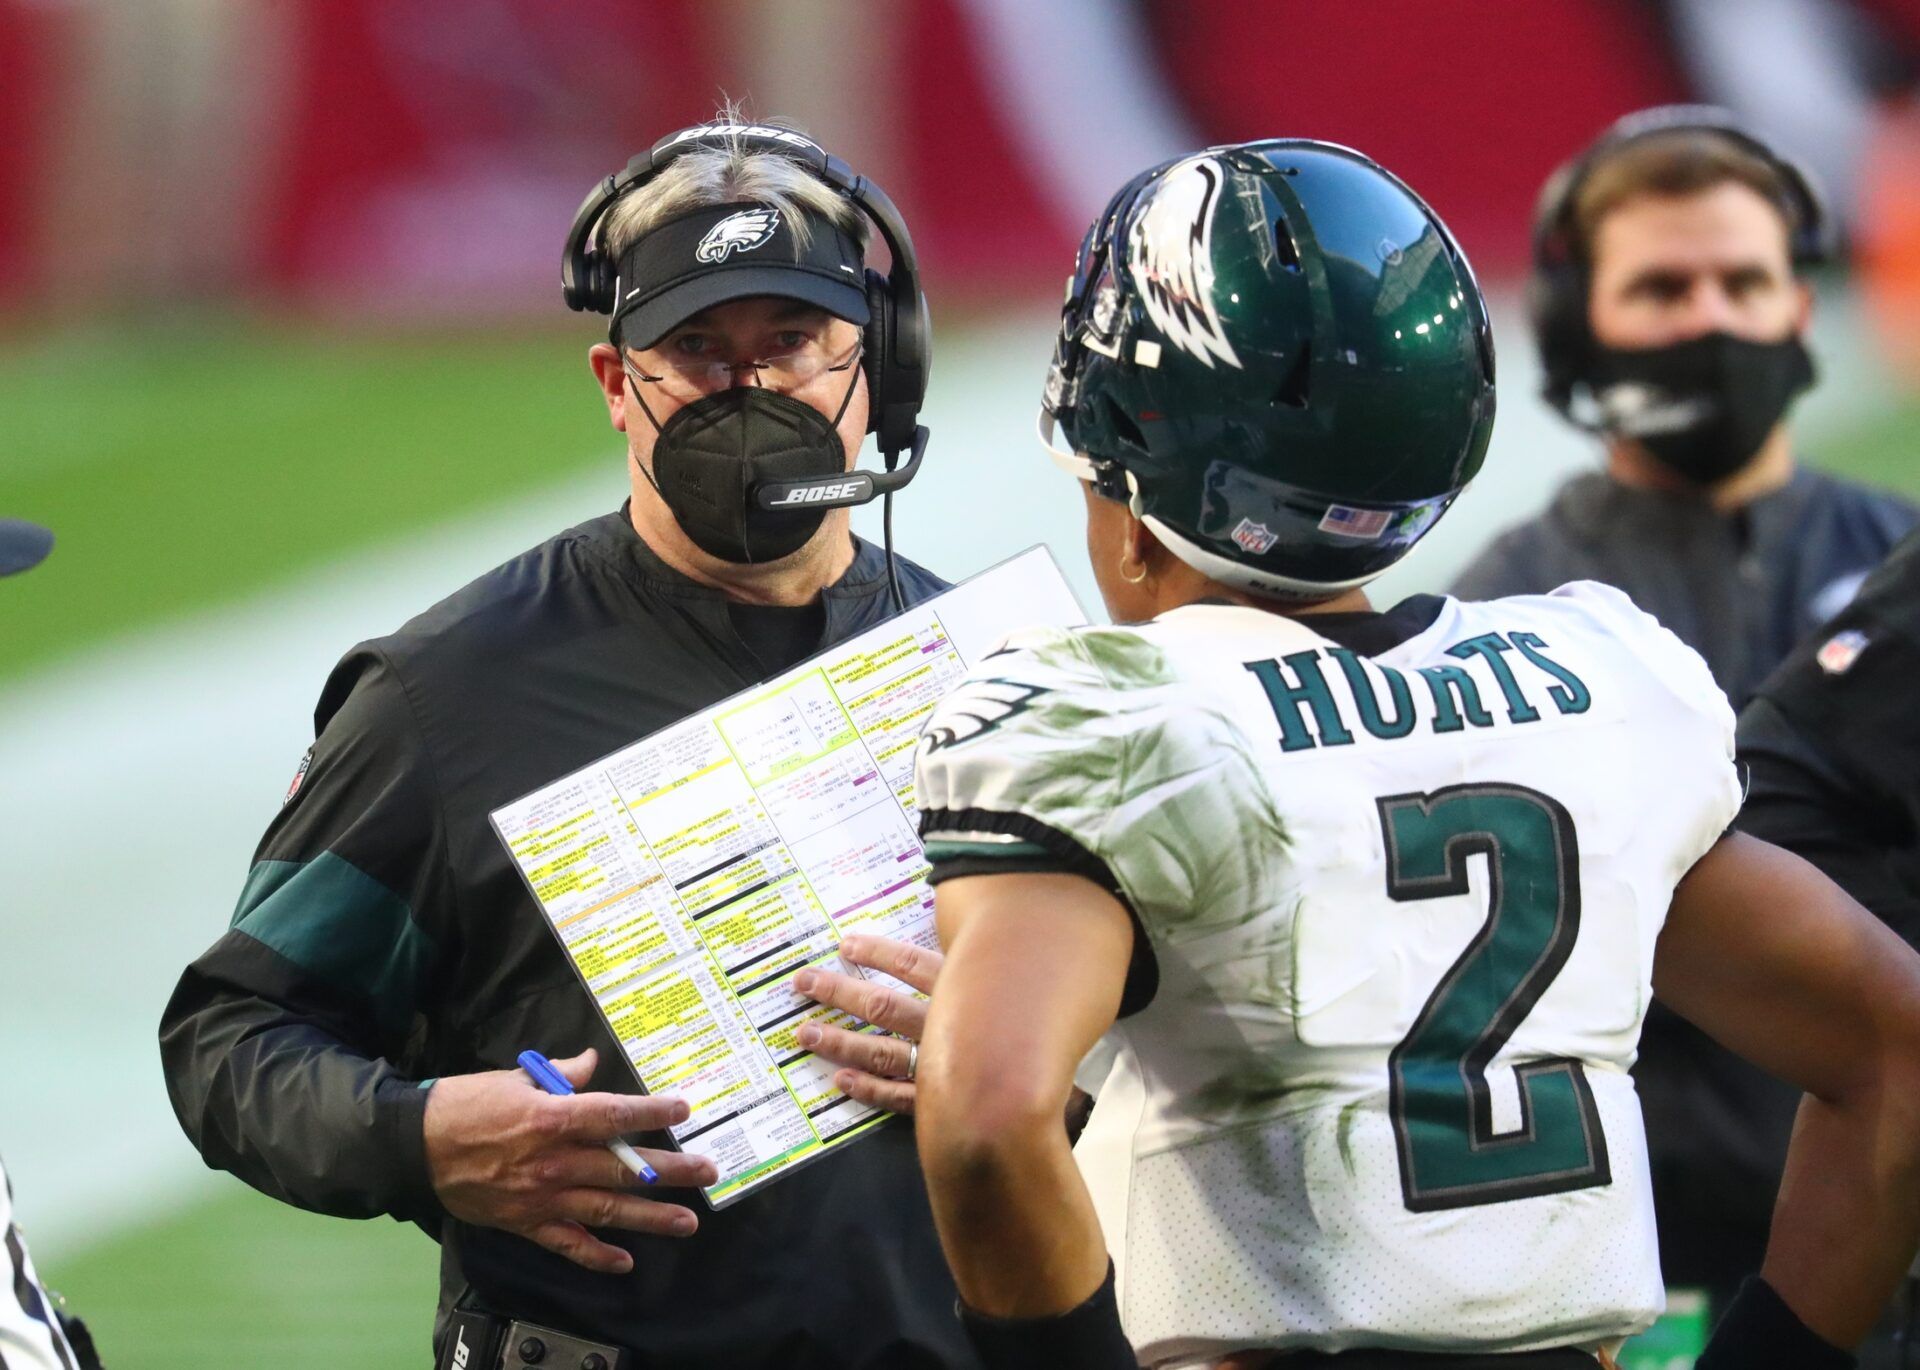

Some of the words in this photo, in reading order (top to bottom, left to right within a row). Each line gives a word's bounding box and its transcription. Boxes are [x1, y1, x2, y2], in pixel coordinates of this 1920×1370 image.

[660, 125, 820, 151] BOSE
[775, 482, 862, 504] BOSE
[1243, 632, 1592, 752] HURTS
[1375, 782, 1612, 1212] 2
